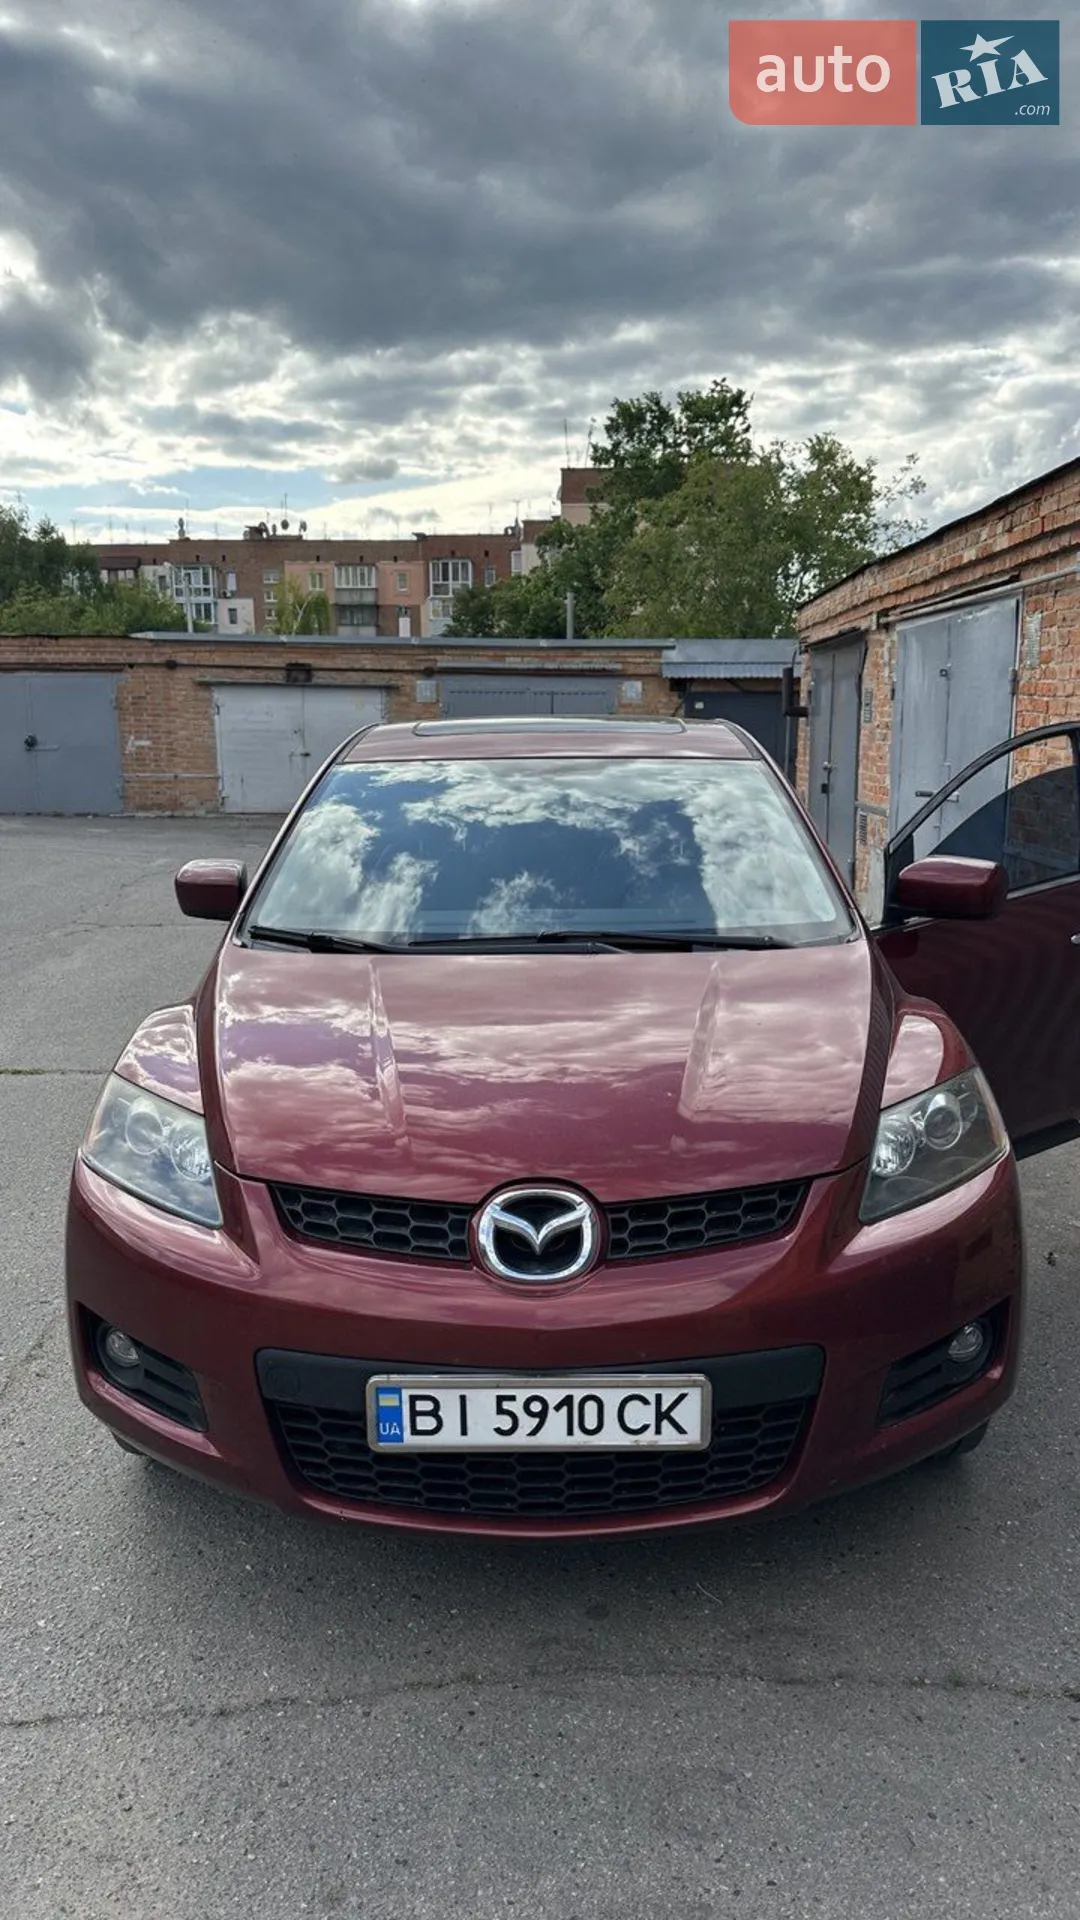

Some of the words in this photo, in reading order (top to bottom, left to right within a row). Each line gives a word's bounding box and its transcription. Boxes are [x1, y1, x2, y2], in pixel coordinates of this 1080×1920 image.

[493, 1394, 605, 1437] 5910
[617, 1393, 689, 1436] CK
[379, 1423, 401, 1436] UA
